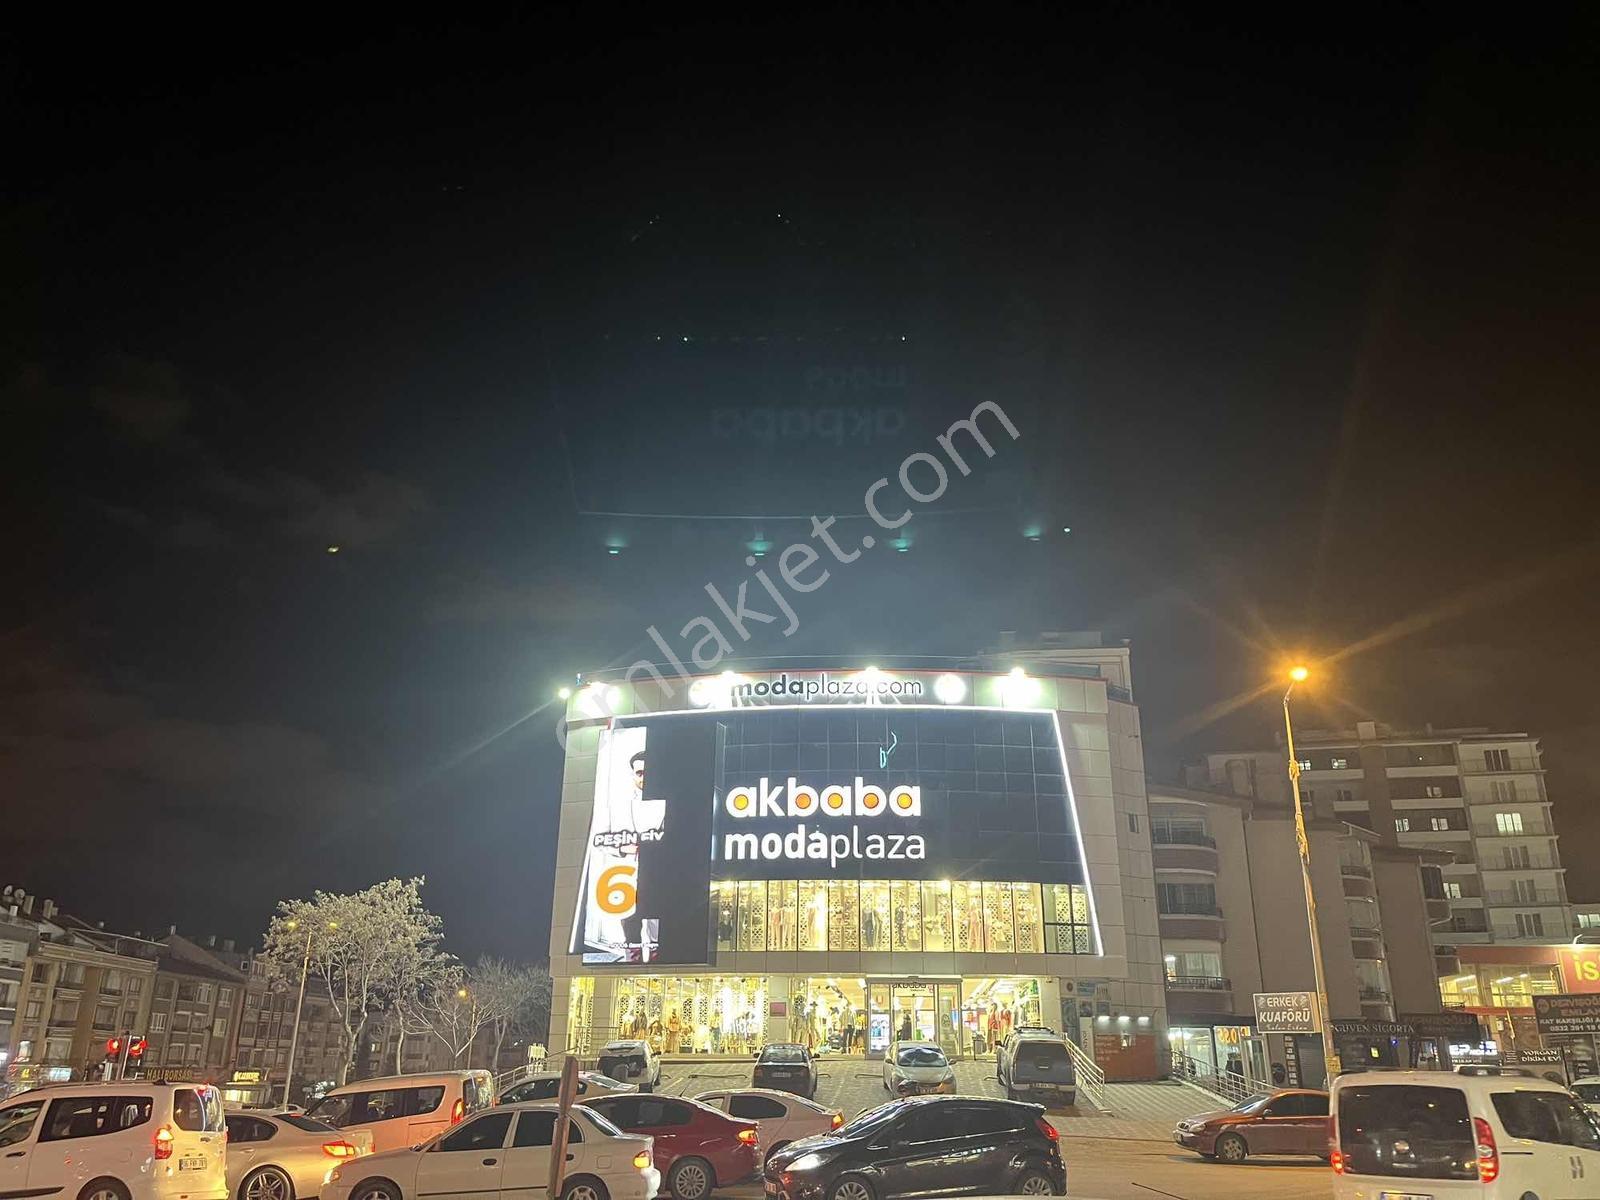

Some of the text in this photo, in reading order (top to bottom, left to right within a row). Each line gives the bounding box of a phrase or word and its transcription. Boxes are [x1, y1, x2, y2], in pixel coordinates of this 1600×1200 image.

[731, 673, 922, 700] modaplaza.com
[725, 776, 922, 818] akbaba
[594, 829, 638, 847] PEŞİN
[724, 824, 926, 868] modaplaza
[596, 865, 637, 914] 6
[1259, 1007, 1311, 1022] KUAFÖRÜ
[1266, 996, 1299, 1007] ERKEK
